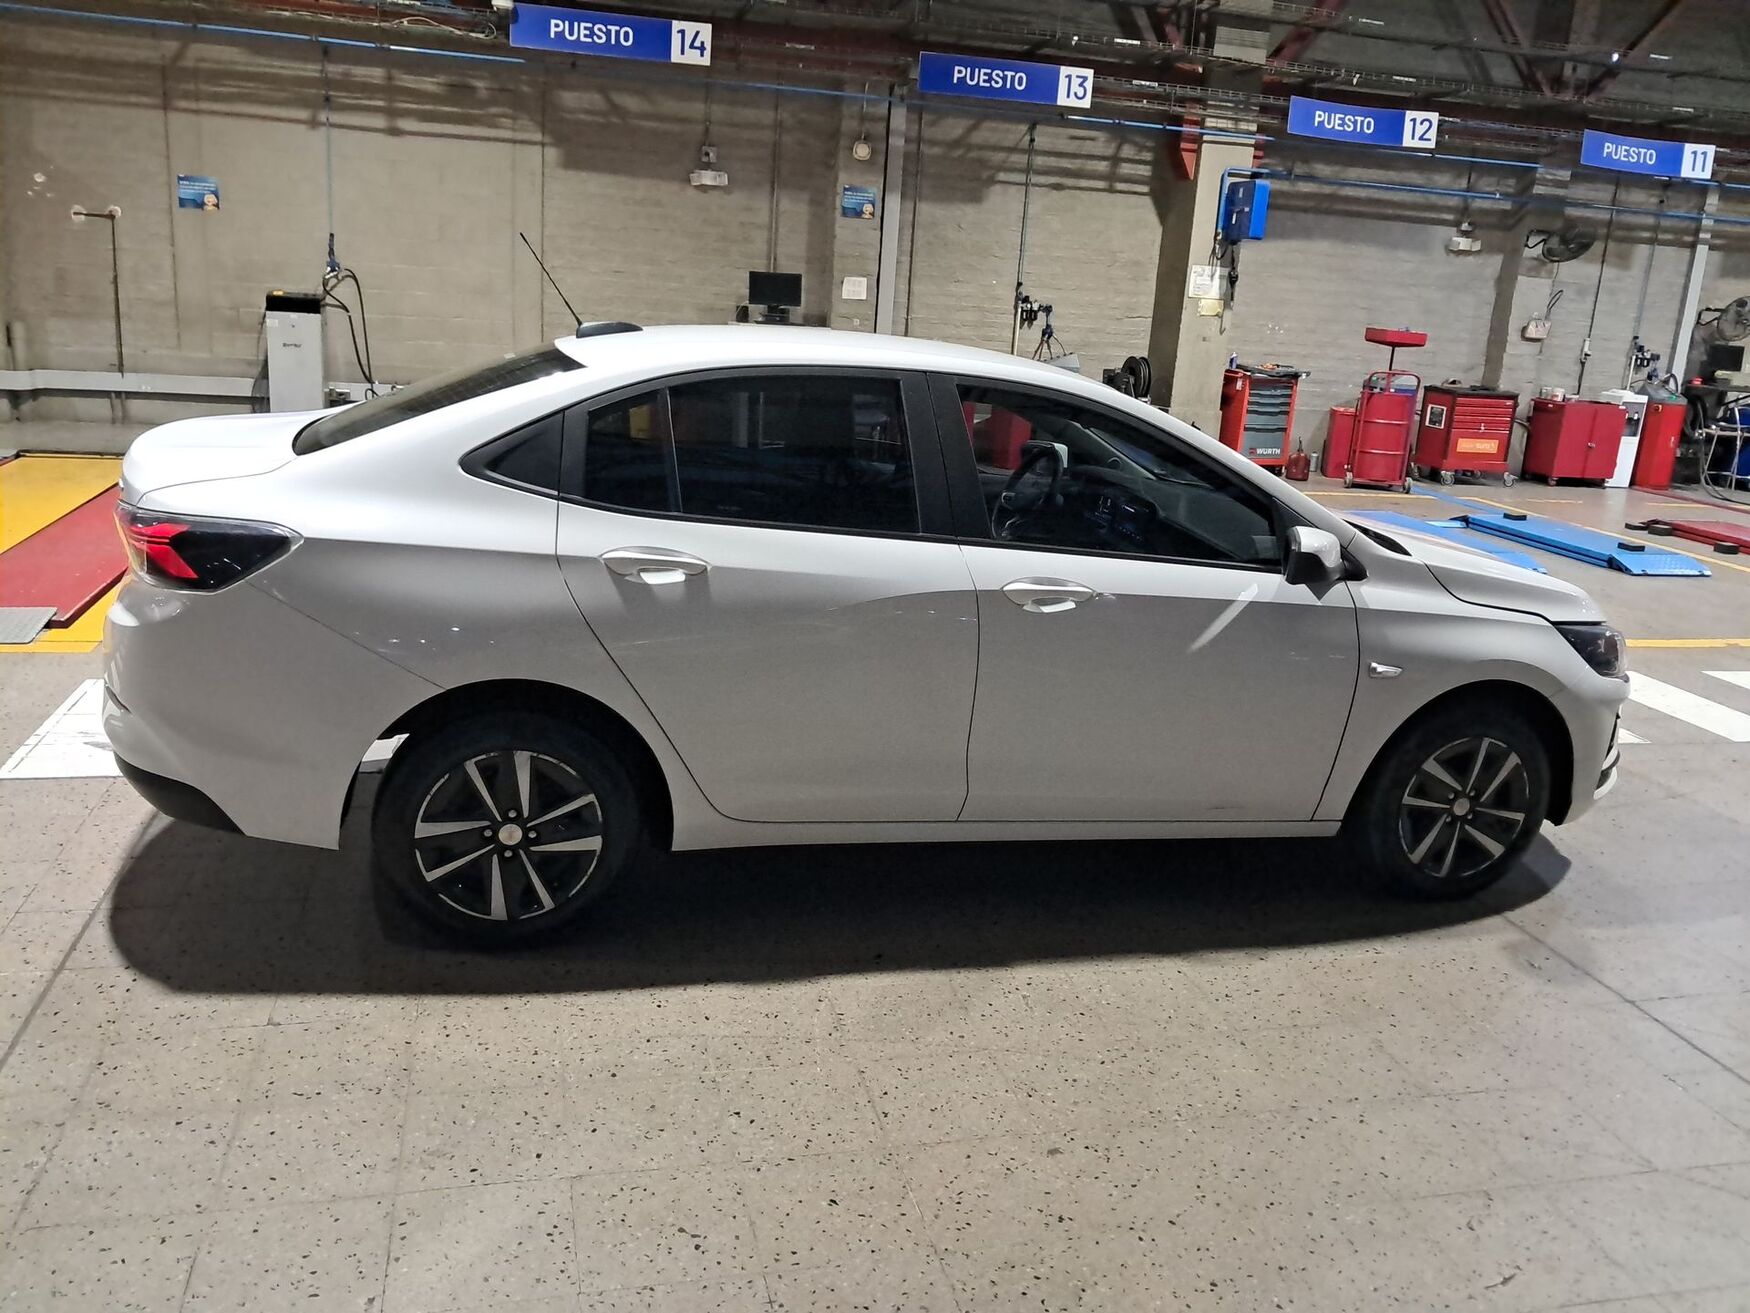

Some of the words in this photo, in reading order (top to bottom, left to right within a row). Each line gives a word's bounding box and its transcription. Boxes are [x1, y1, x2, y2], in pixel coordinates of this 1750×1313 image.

[550, 19, 634, 47] PUESTO
[676, 28, 707, 58] 14
[953, 65, 1027, 91] PUESTO
[1064, 73, 1089, 101] 13
[1314, 110, 1375, 134] PUESTO
[1409, 117, 1434, 142] 12
[1603, 142, 1657, 165] PUESTO
[1690, 150, 1708, 173] 11
